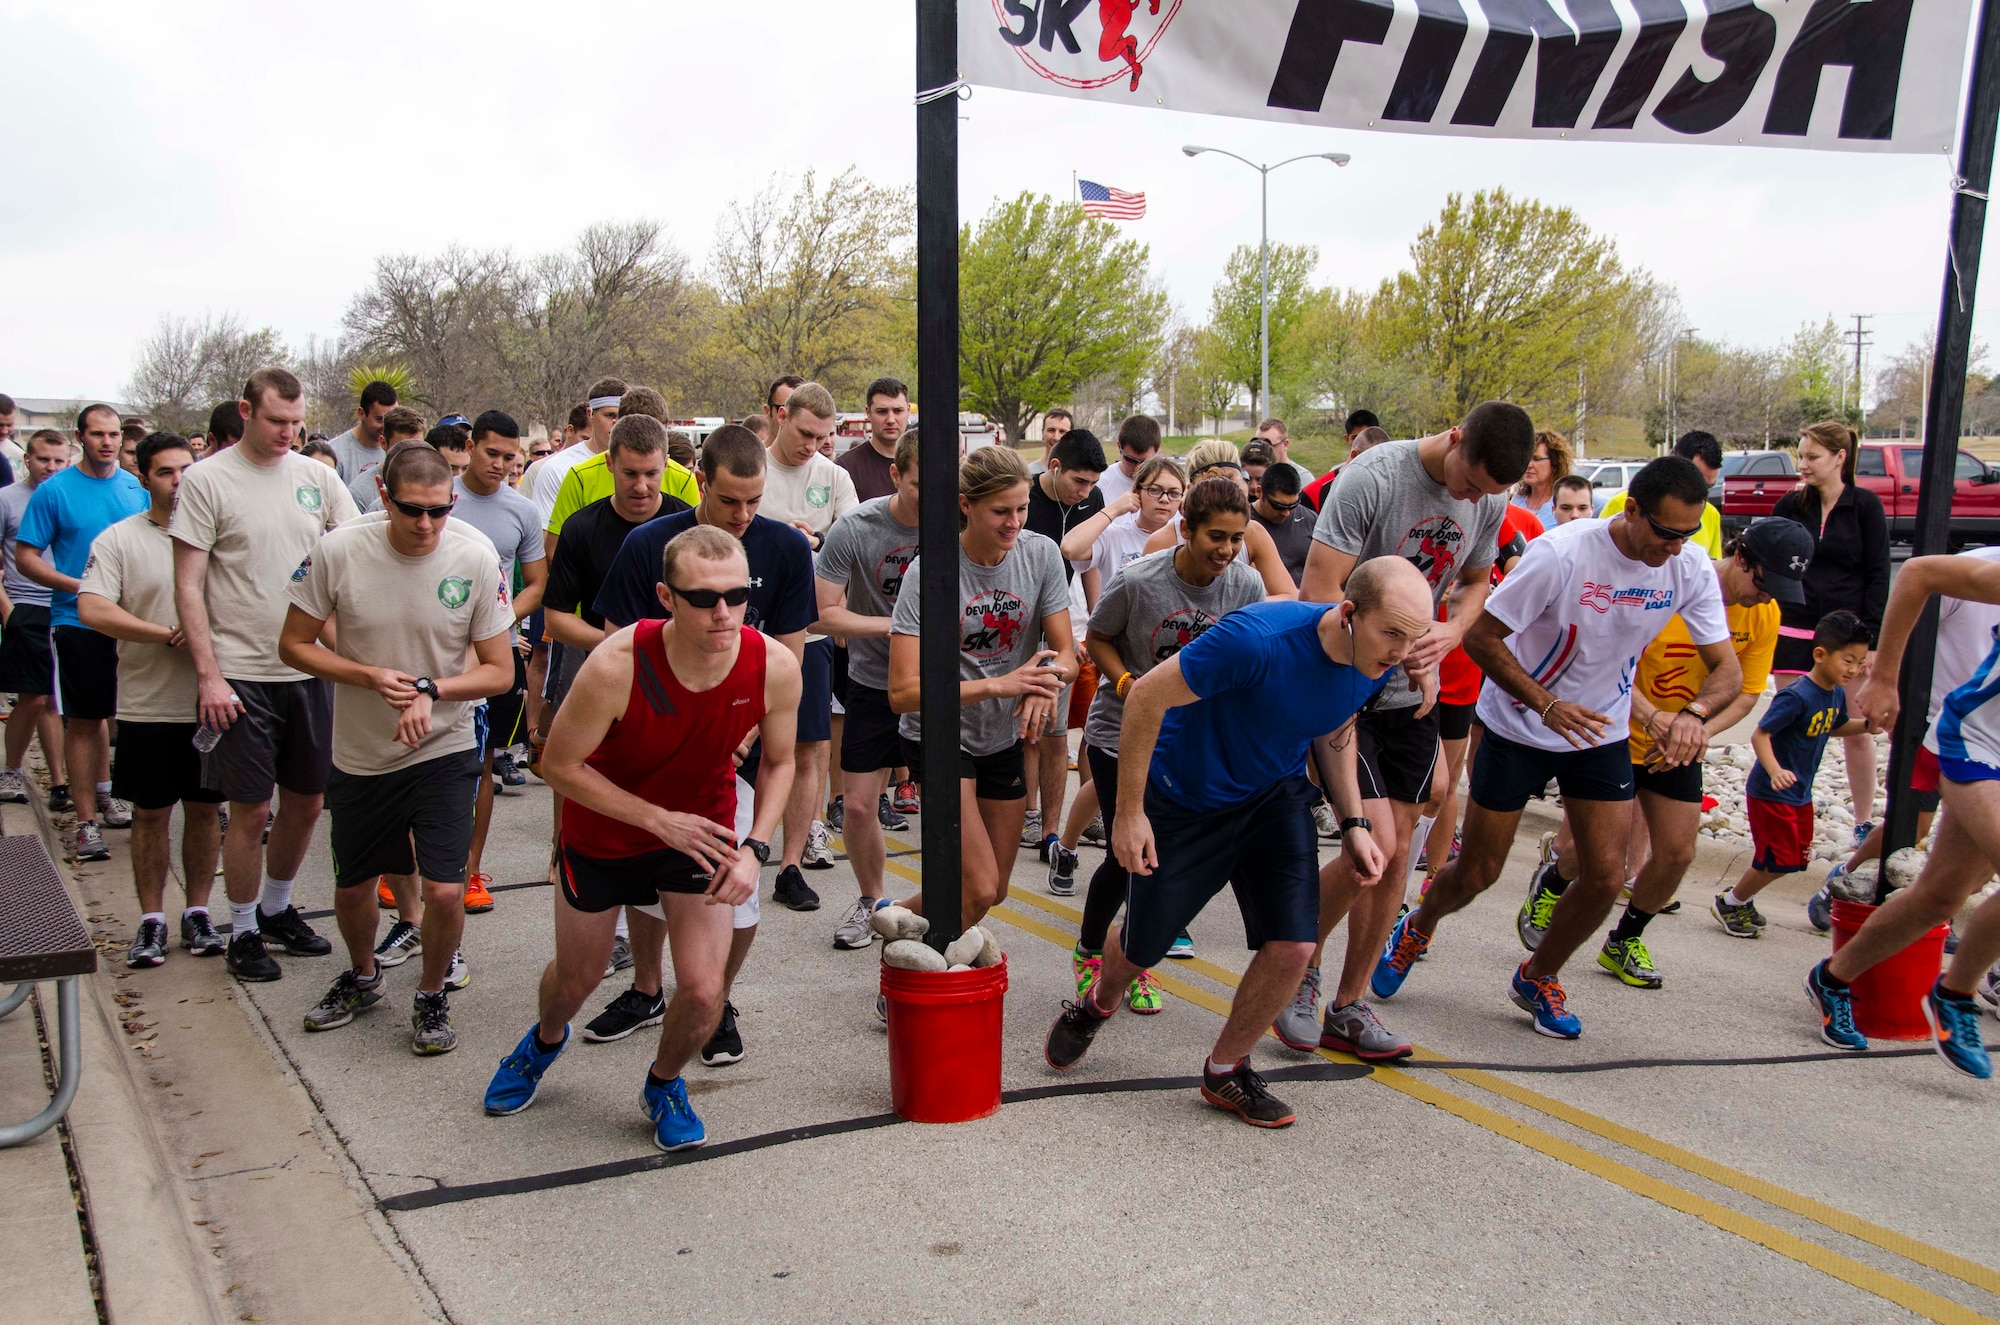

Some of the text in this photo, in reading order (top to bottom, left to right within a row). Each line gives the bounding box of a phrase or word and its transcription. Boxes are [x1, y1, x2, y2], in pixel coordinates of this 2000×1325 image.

[999, 0, 1092, 54] 5K
[1267, 0, 1914, 140] FINISH
[1436, 529, 1463, 542] DASH
[885, 555, 909, 565] DEVIL
[1579, 582, 1613, 613] 25
[966, 600, 1021, 617] DEVIL DASH
[1162, 620, 1189, 631] DEVIL
[961, 630, 1000, 652] 5K
